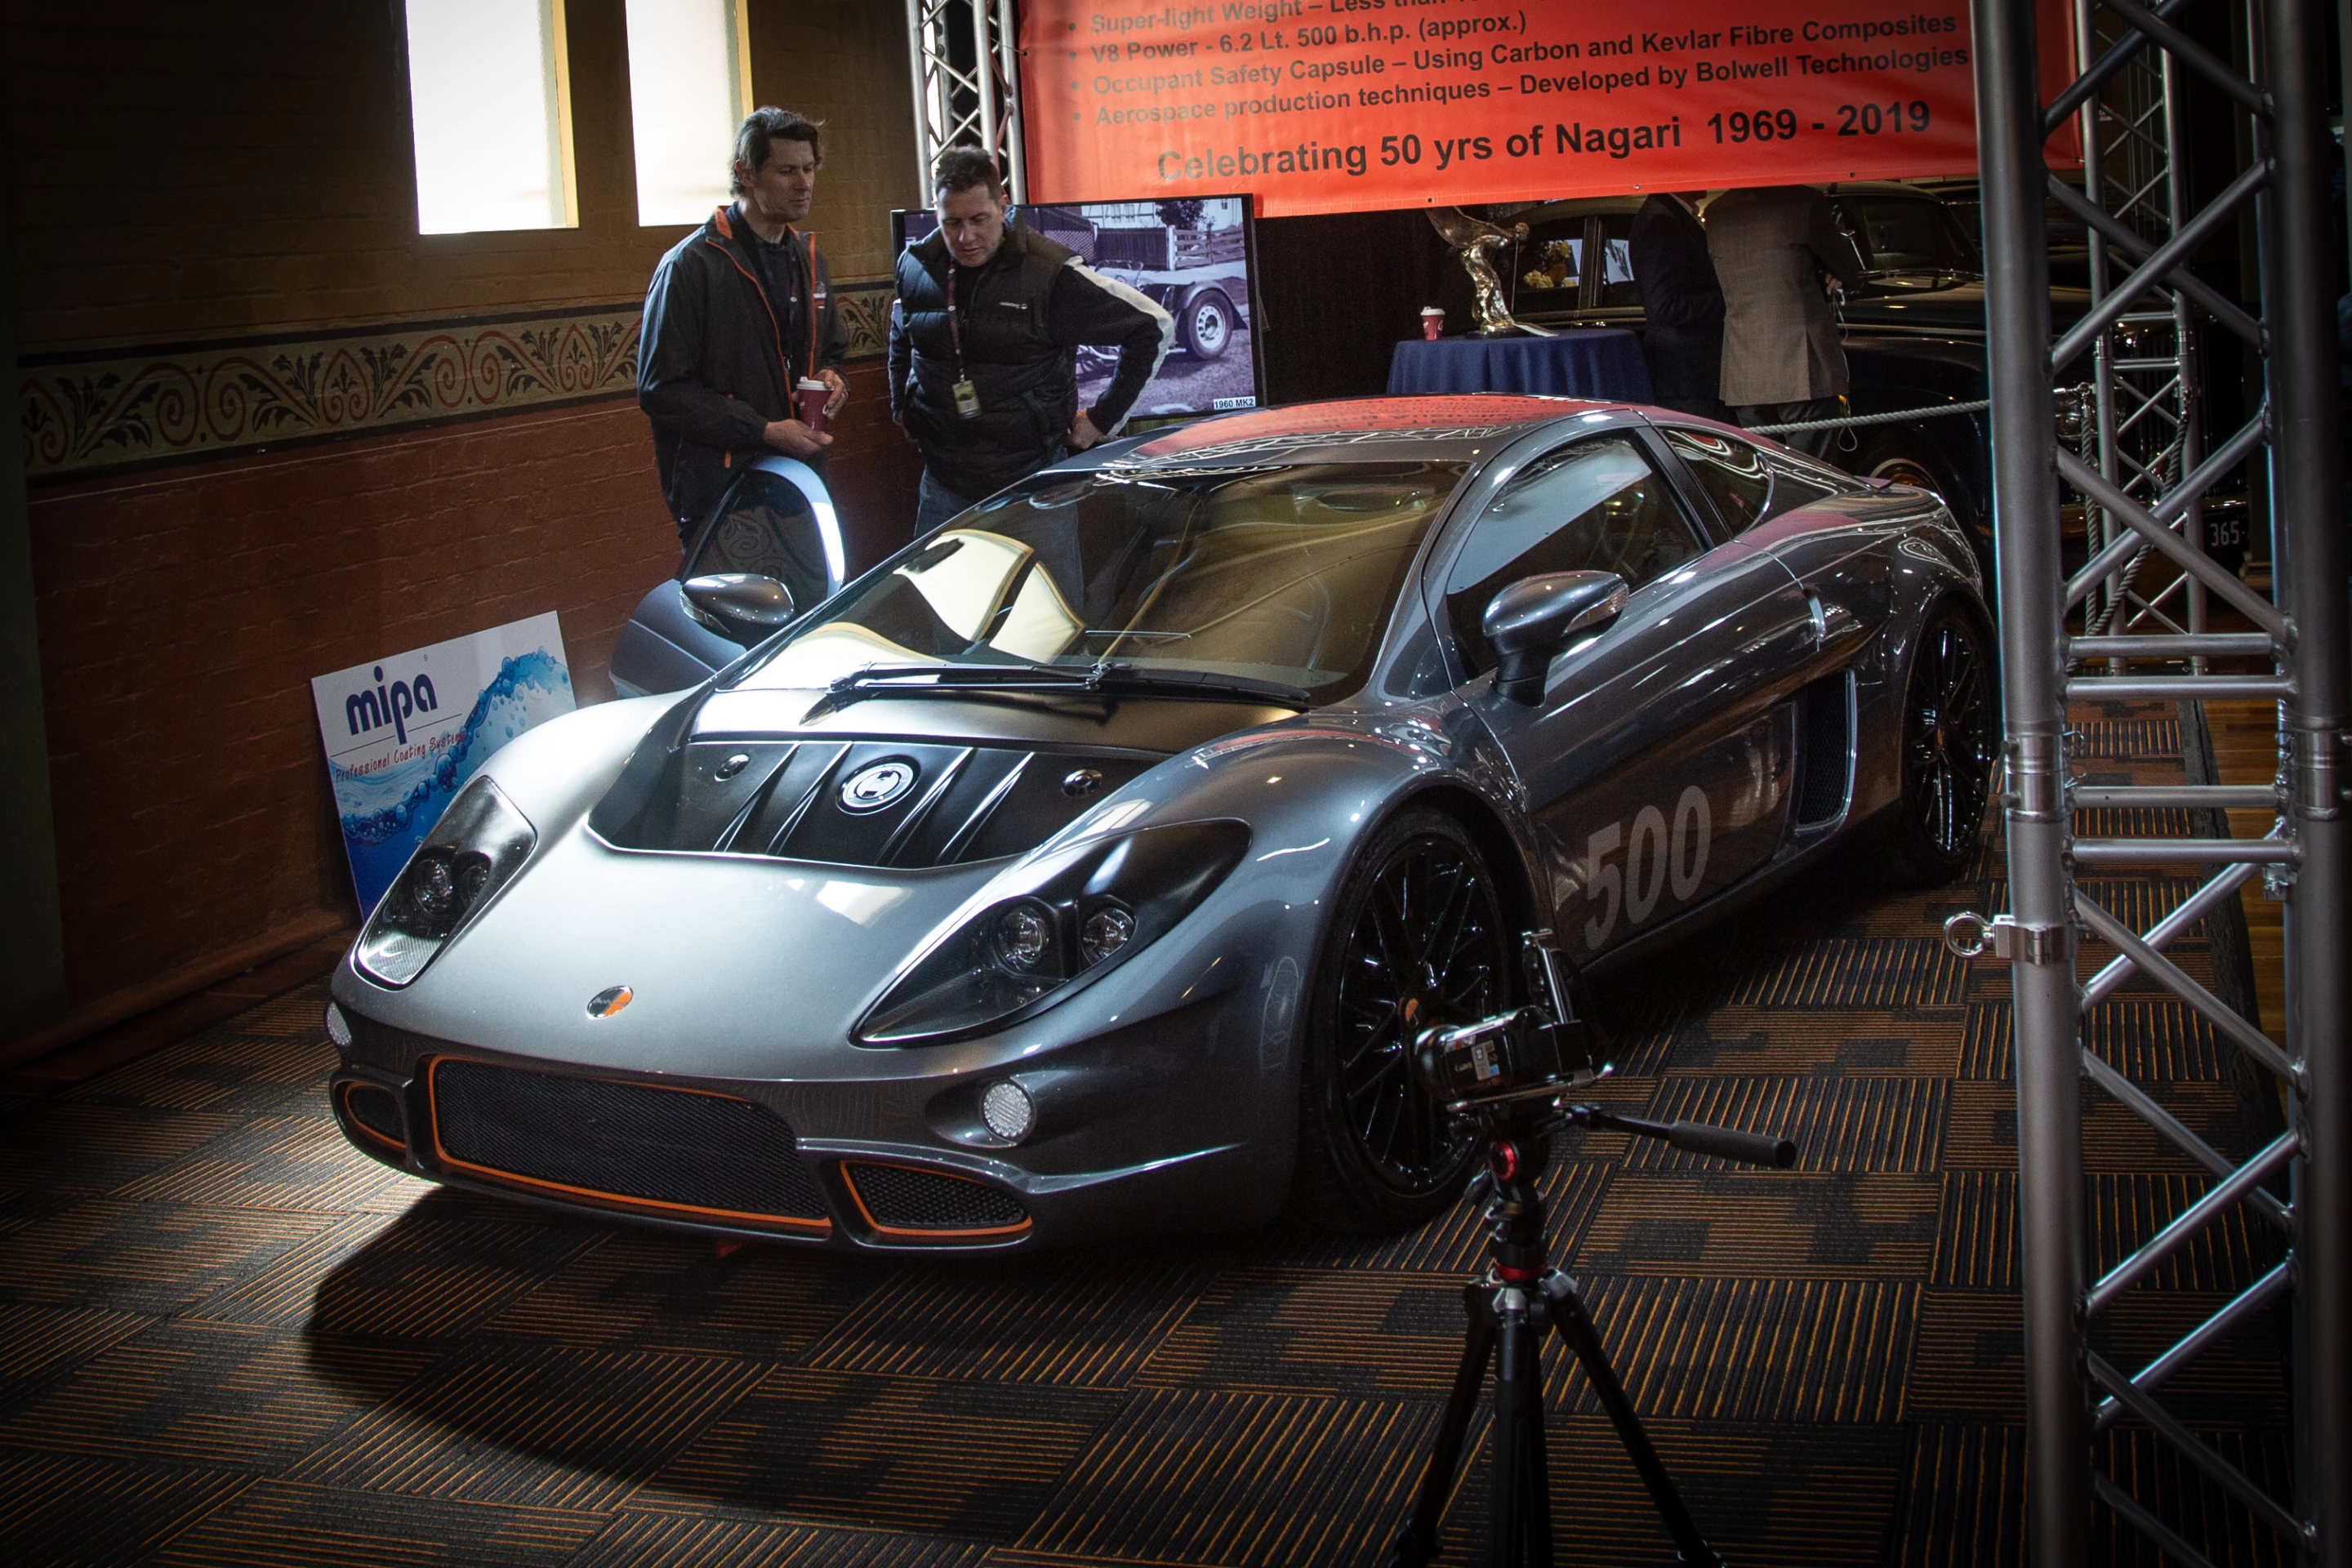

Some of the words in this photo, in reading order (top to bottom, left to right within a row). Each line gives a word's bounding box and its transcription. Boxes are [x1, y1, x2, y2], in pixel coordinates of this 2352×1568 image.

[1090, 43, 1120, 63] V8
[1127, 41, 1198, 60] Power
[1219, 33, 1253, 53] 6.2
[1260, 31, 1289, 50] Lt.
[1298, 25, 1337, 47] 500
[1345, 22, 1410, 45] b.h.p.
[1419, 10, 1526, 42] (approx.)
[1092, 7, 1214, 34] Super-light
[1222, 0, 1303, 24] Weight
[1330, 0, 1386, 13] Less
[1094, 70, 1202, 94] Occupant
[1211, 65, 1281, 86] Safety
[1290, 55, 1385, 82] Capsule
[1414, 48, 1483, 71] Using
[1491, 41, 1579, 64] Carbon
[1588, 34, 1633, 57] and
[1642, 29, 1722, 53] Kevlar
[1730, 24, 1793, 47] Fibre
[1802, 14, 1957, 42] Composites
[1097, 104, 1215, 124] Aerospace
[1225, 91, 1350, 120] production
[1358, 82, 1490, 106] techniques
[1520, 66, 1650, 95] Developed
[1658, 65, 1687, 89] by
[1696, 56, 1788, 82] Bolwell
[1796, 46, 1969, 73] Technologies
[1158, 141, 1366, 179] Celebrating
[1381, 134, 1421, 166] 50
[1433, 136, 1493, 171] yrs
[1506, 124, 1544, 158] of
[1556, 115, 1681, 159] Nagari
[1708, 109, 1797, 144] 1969
[1837, 99, 1931, 136] 2019
[1214, 399, 1233, 408] 1960
[1236, 399, 1254, 407] MK2
[345, 666, 438, 745] mipa
[336, 752, 390, 782] Professional
[394, 743, 425, 764] Coating
[429, 731, 466, 753] Systems
[1584, 786, 1711, 950] 500
